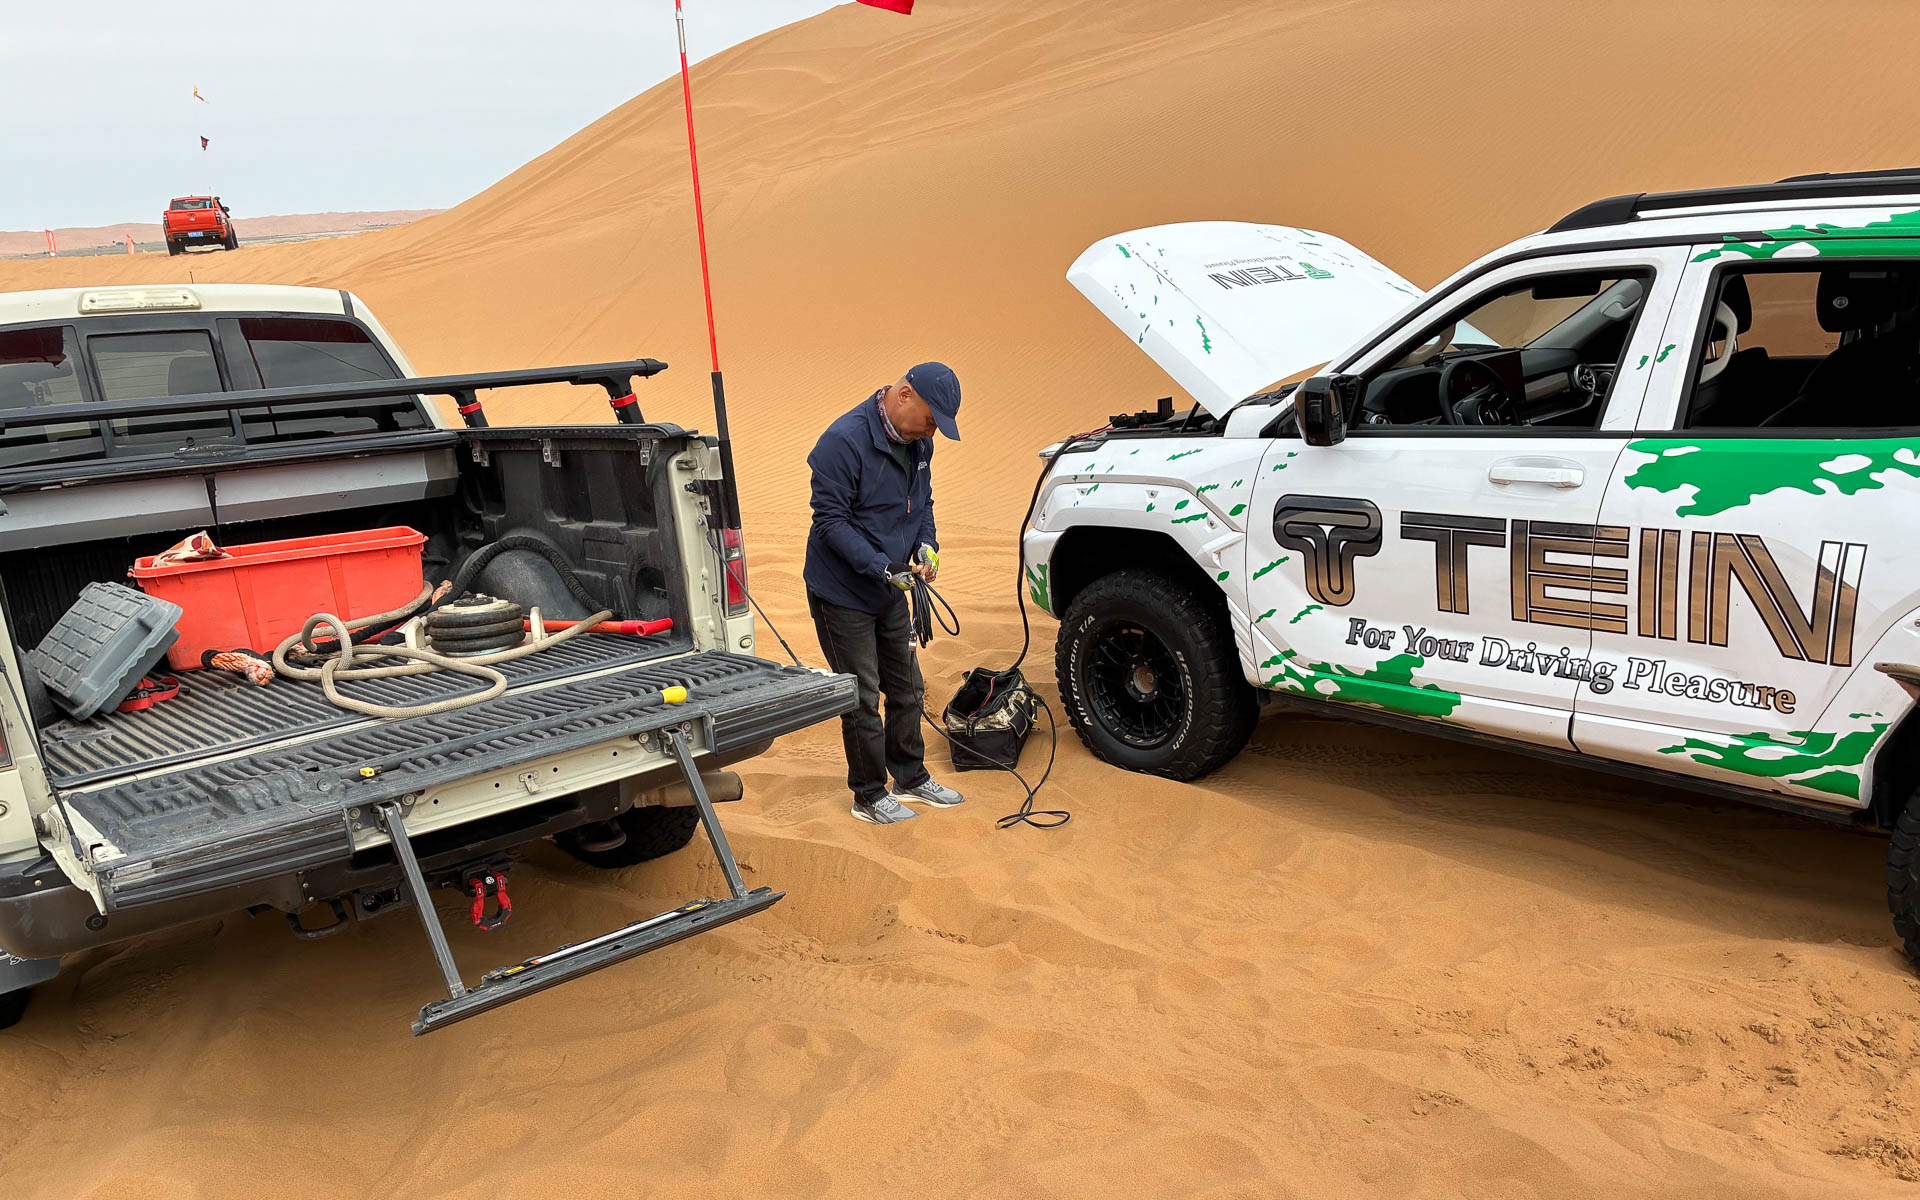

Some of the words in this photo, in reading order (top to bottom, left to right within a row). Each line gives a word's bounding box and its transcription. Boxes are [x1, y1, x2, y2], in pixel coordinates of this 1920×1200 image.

[1207, 265, 1307, 290] TEIN
[1078, 614, 1096, 634] T/A
[1400, 510, 1869, 668] TEIN
[1070, 638, 1094, 727] All-Terrain
[1345, 617, 1395, 651] For
[1402, 625, 1474, 663] Your
[1479, 636, 1617, 694] Driving
[1623, 656, 1796, 714] Pleasure
